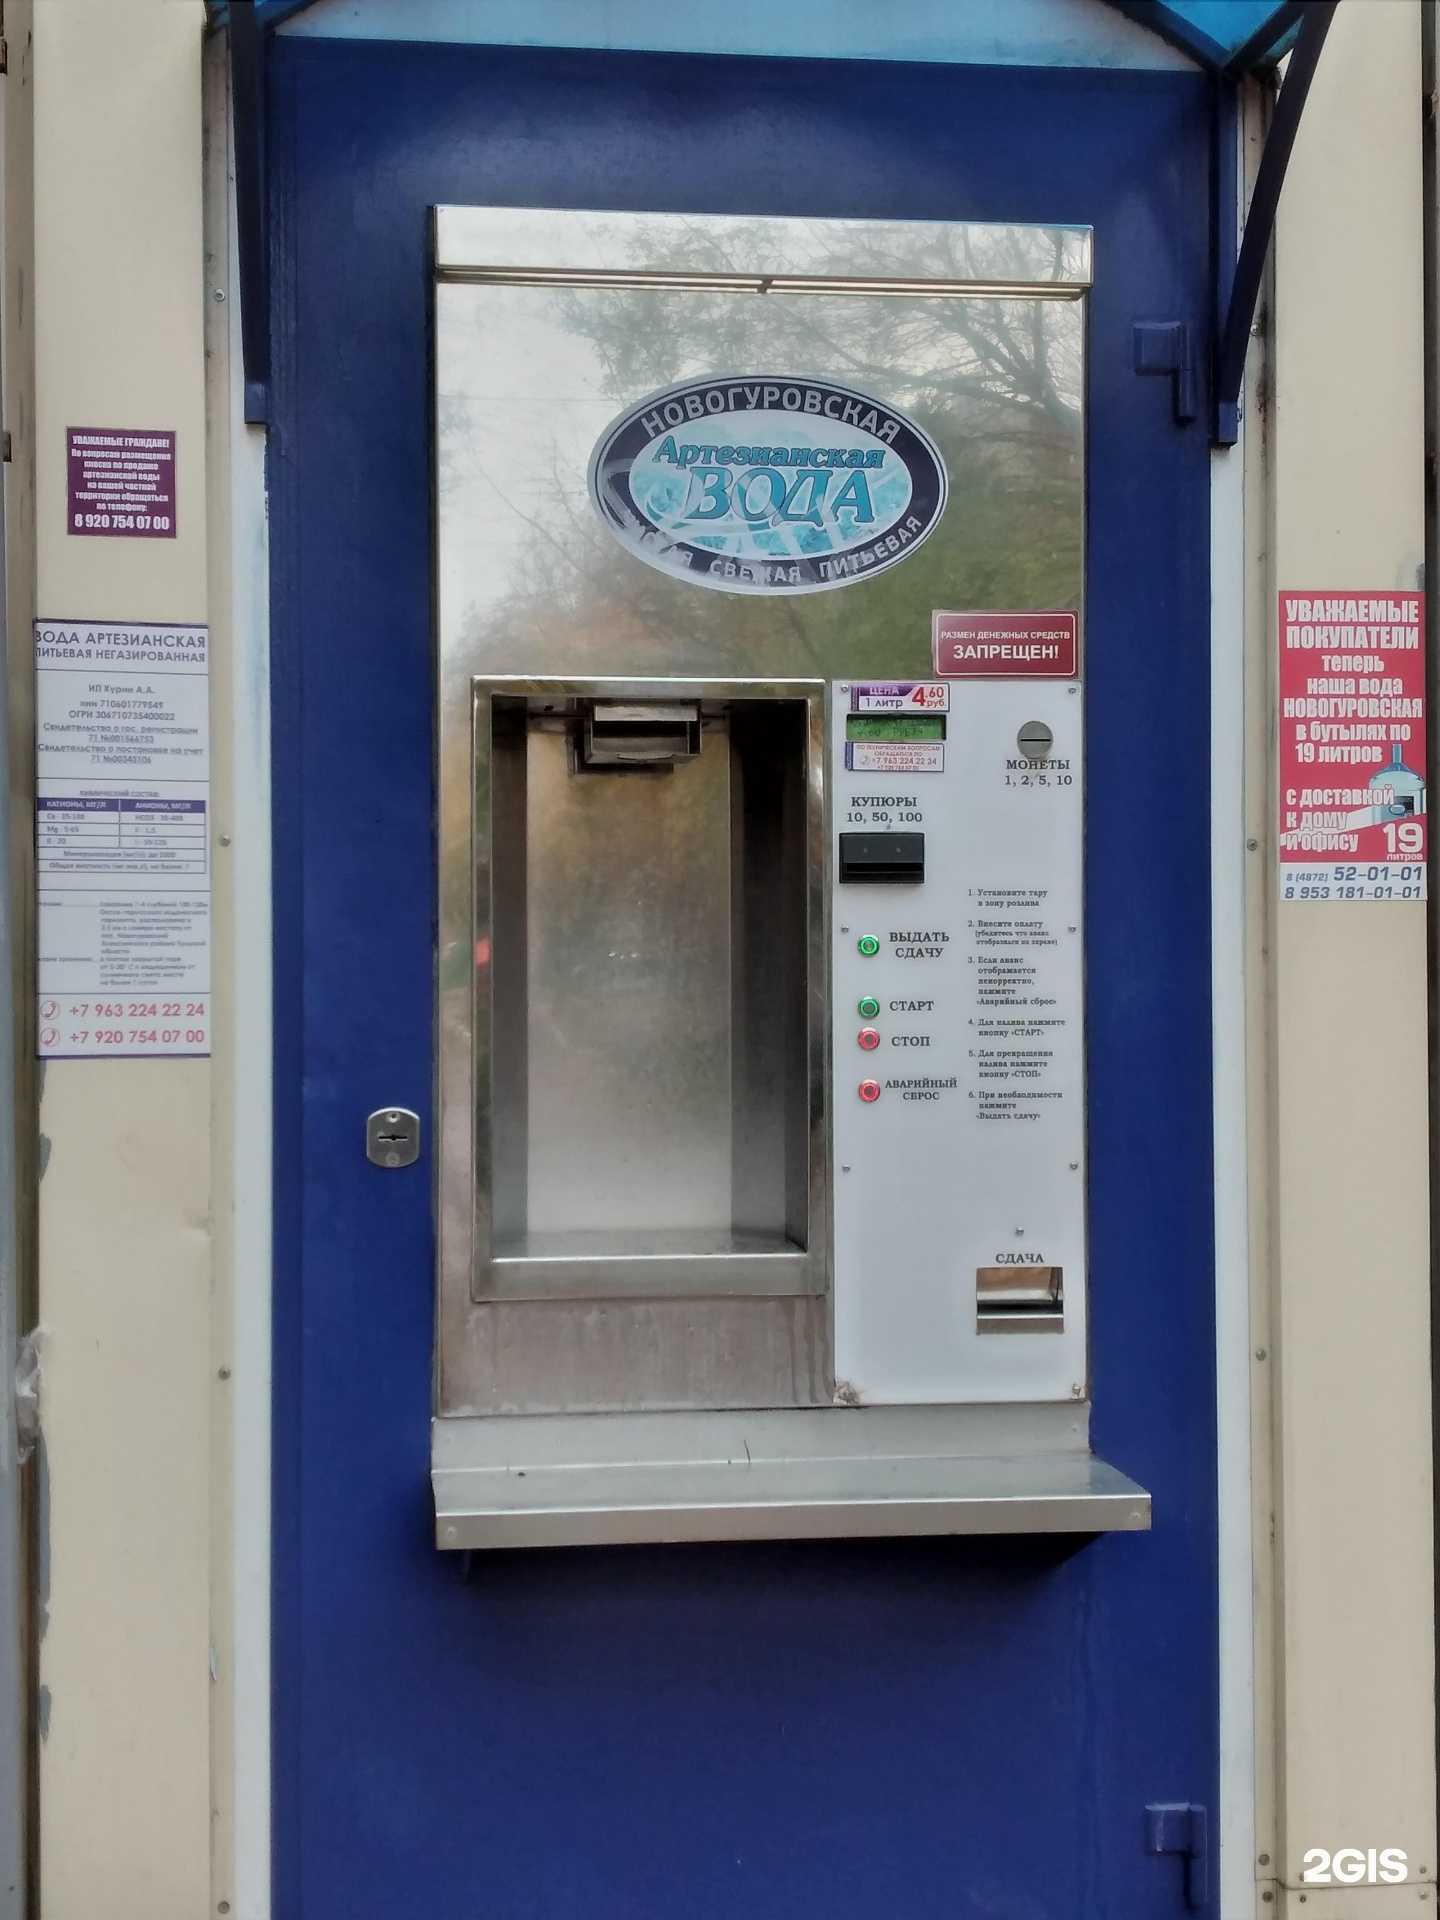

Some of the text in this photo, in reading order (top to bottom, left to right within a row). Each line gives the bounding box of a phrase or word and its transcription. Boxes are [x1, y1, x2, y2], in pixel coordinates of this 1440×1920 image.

[640, 385, 901, 445] НОВОГУРОВСКАЯ
[651, 435, 887, 470] Артезианская
[684, 466, 876, 527] ВОДА
[74, 514, 170, 530] 8 920 754 07 00
[709, 515, 923, 585] СВЕЖАЯ ПИТЬЕВАЯ
[1284, 599, 1419, 623] УВАЖАЕМЫЕ
[86, 633, 206, 648] АРТЕЗИАНСКАЯ
[941, 631, 1070, 640] РАЗМЕН ДЕНЕЖНЫХ СРЕДСТВ
[1286, 626, 1419, 649] ПОКУПАТЕЛИ
[35, 647, 205, 662] ПИТЬЕВАЯ НЕГАЗИРОВАННАЯ
[953, 644, 1060, 662] ЗАПРЕЩЕН!
[1321, 655, 1385, 673] теперь
[88, 684, 102, 693] ИП
[869, 687, 900, 695] ЦЕНА
[1307, 677, 1403, 697] наша вода
[875, 699, 903, 709] литр
[1283, 698, 1423, 718] НОВОГУРОВСКАЯ
[68, 710, 93, 719] ОГРН
[1295, 721, 1411, 742] в бутылях по
[1295, 742, 1383, 764] 19 литров
[1006, 759, 1071, 770] МОНЕТЫ
[1004, 775, 1073, 787] 1, 2, 5, 10
[851, 796, 917, 807] КУПЮРЫ
[1300, 784, 1394, 808] доставкой
[847, 812, 923, 824] 10, 50, 100
[1300, 812, 1348, 831] дому
[1286, 832, 1359, 852] и офису
[1383, 822, 1424, 853] 19
[1386, 853, 1424, 861] литров
[1295, 873, 1329, 883] (4872)
[1333, 866, 1422, 881] 52-01-01
[977, 888, 1048, 898] Установите тару
[1284, 886, 1422, 899] 8 953 181-01-01
[889, 932, 949, 943] ВЫДАТЬ
[895, 947, 943, 959] СДАЧУ
[69, 1003, 205, 1017] +7 963 224 22 24
[889, 1001, 934, 1011] СТАРТ
[69, 1030, 205, 1044] +7 920 754 07 00
[891, 1036, 930, 1047] СТОП
[885, 1077, 957, 1089] АВАРИЙНЫЙ
[903, 1092, 940, 1100] СБРОС
[995, 1253, 1045, 1264] СДАЧА
